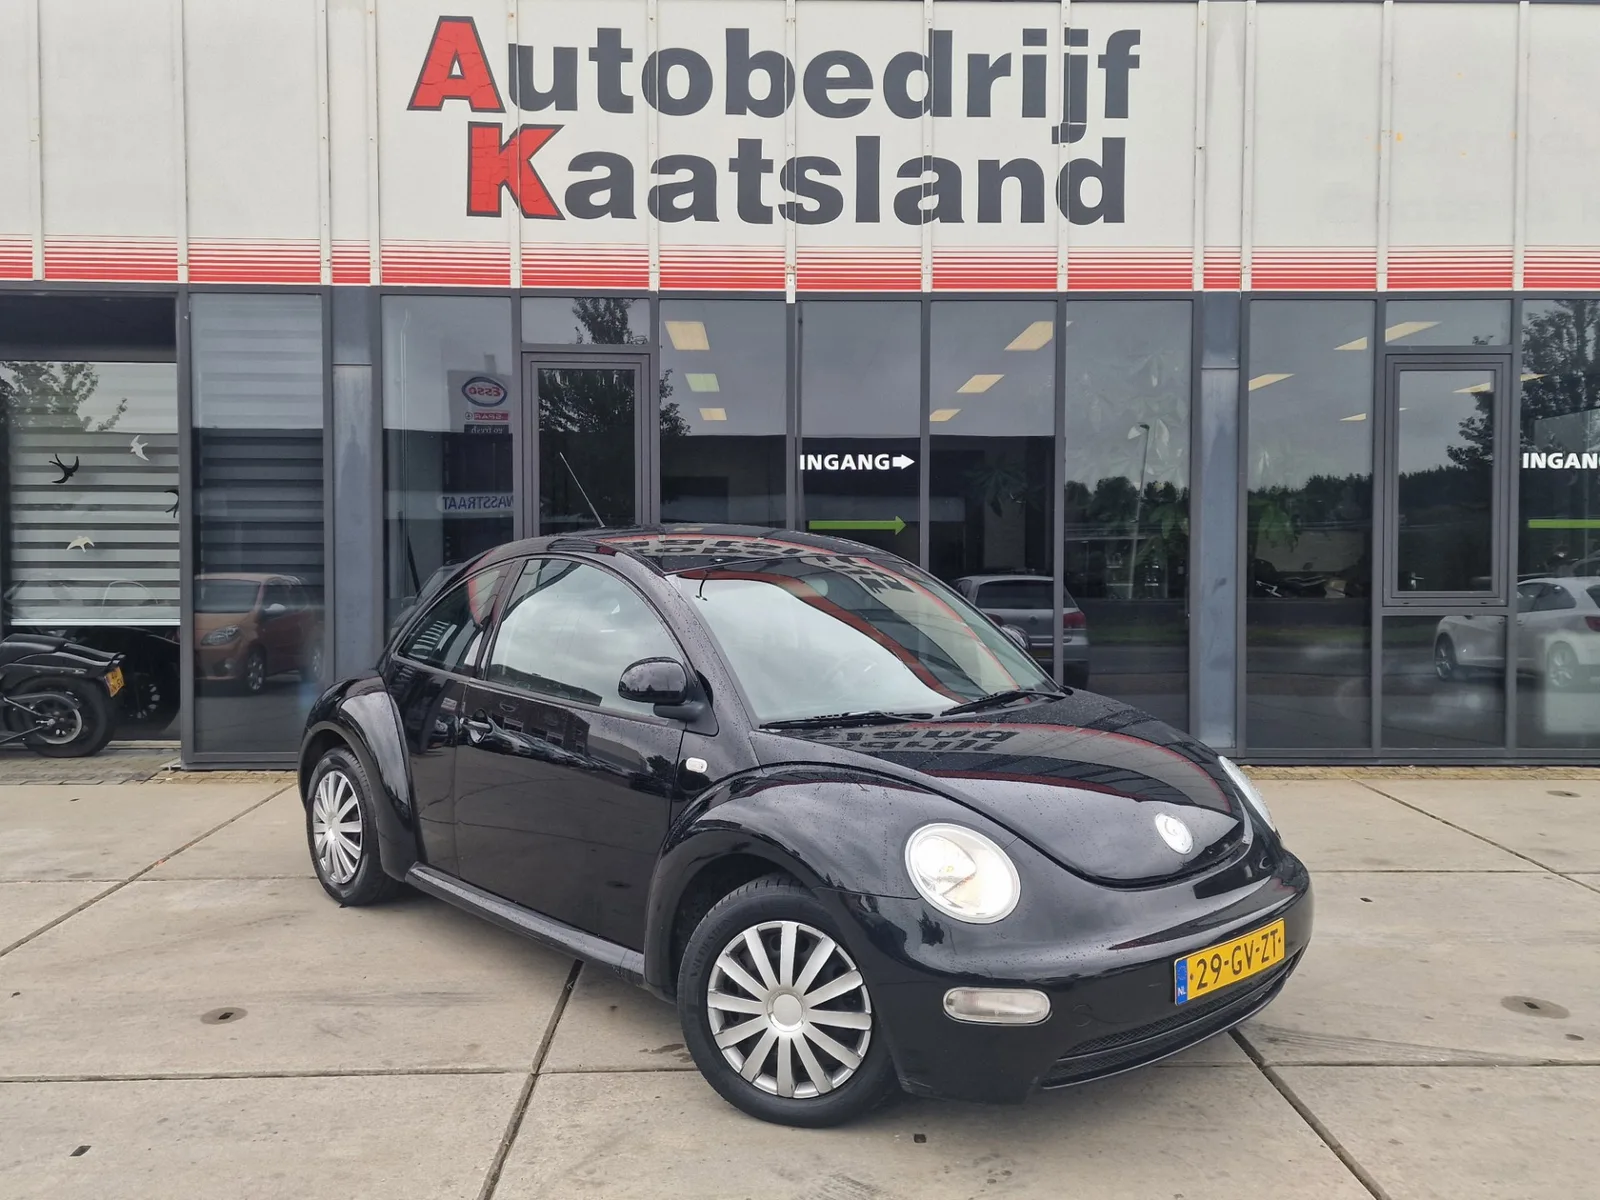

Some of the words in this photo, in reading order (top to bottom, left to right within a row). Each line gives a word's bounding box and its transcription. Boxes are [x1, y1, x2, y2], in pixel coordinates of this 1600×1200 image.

[406, 15, 1141, 144] Autobedrijf
[466, 121, 1126, 224] Kaatsland
[800, 454, 890, 471] INGANG
[1522, 452, 1600, 469] INGAN
[1196, 928, 1279, 990] 29-GV-ZT
[1177, 986, 1187, 997] NL
